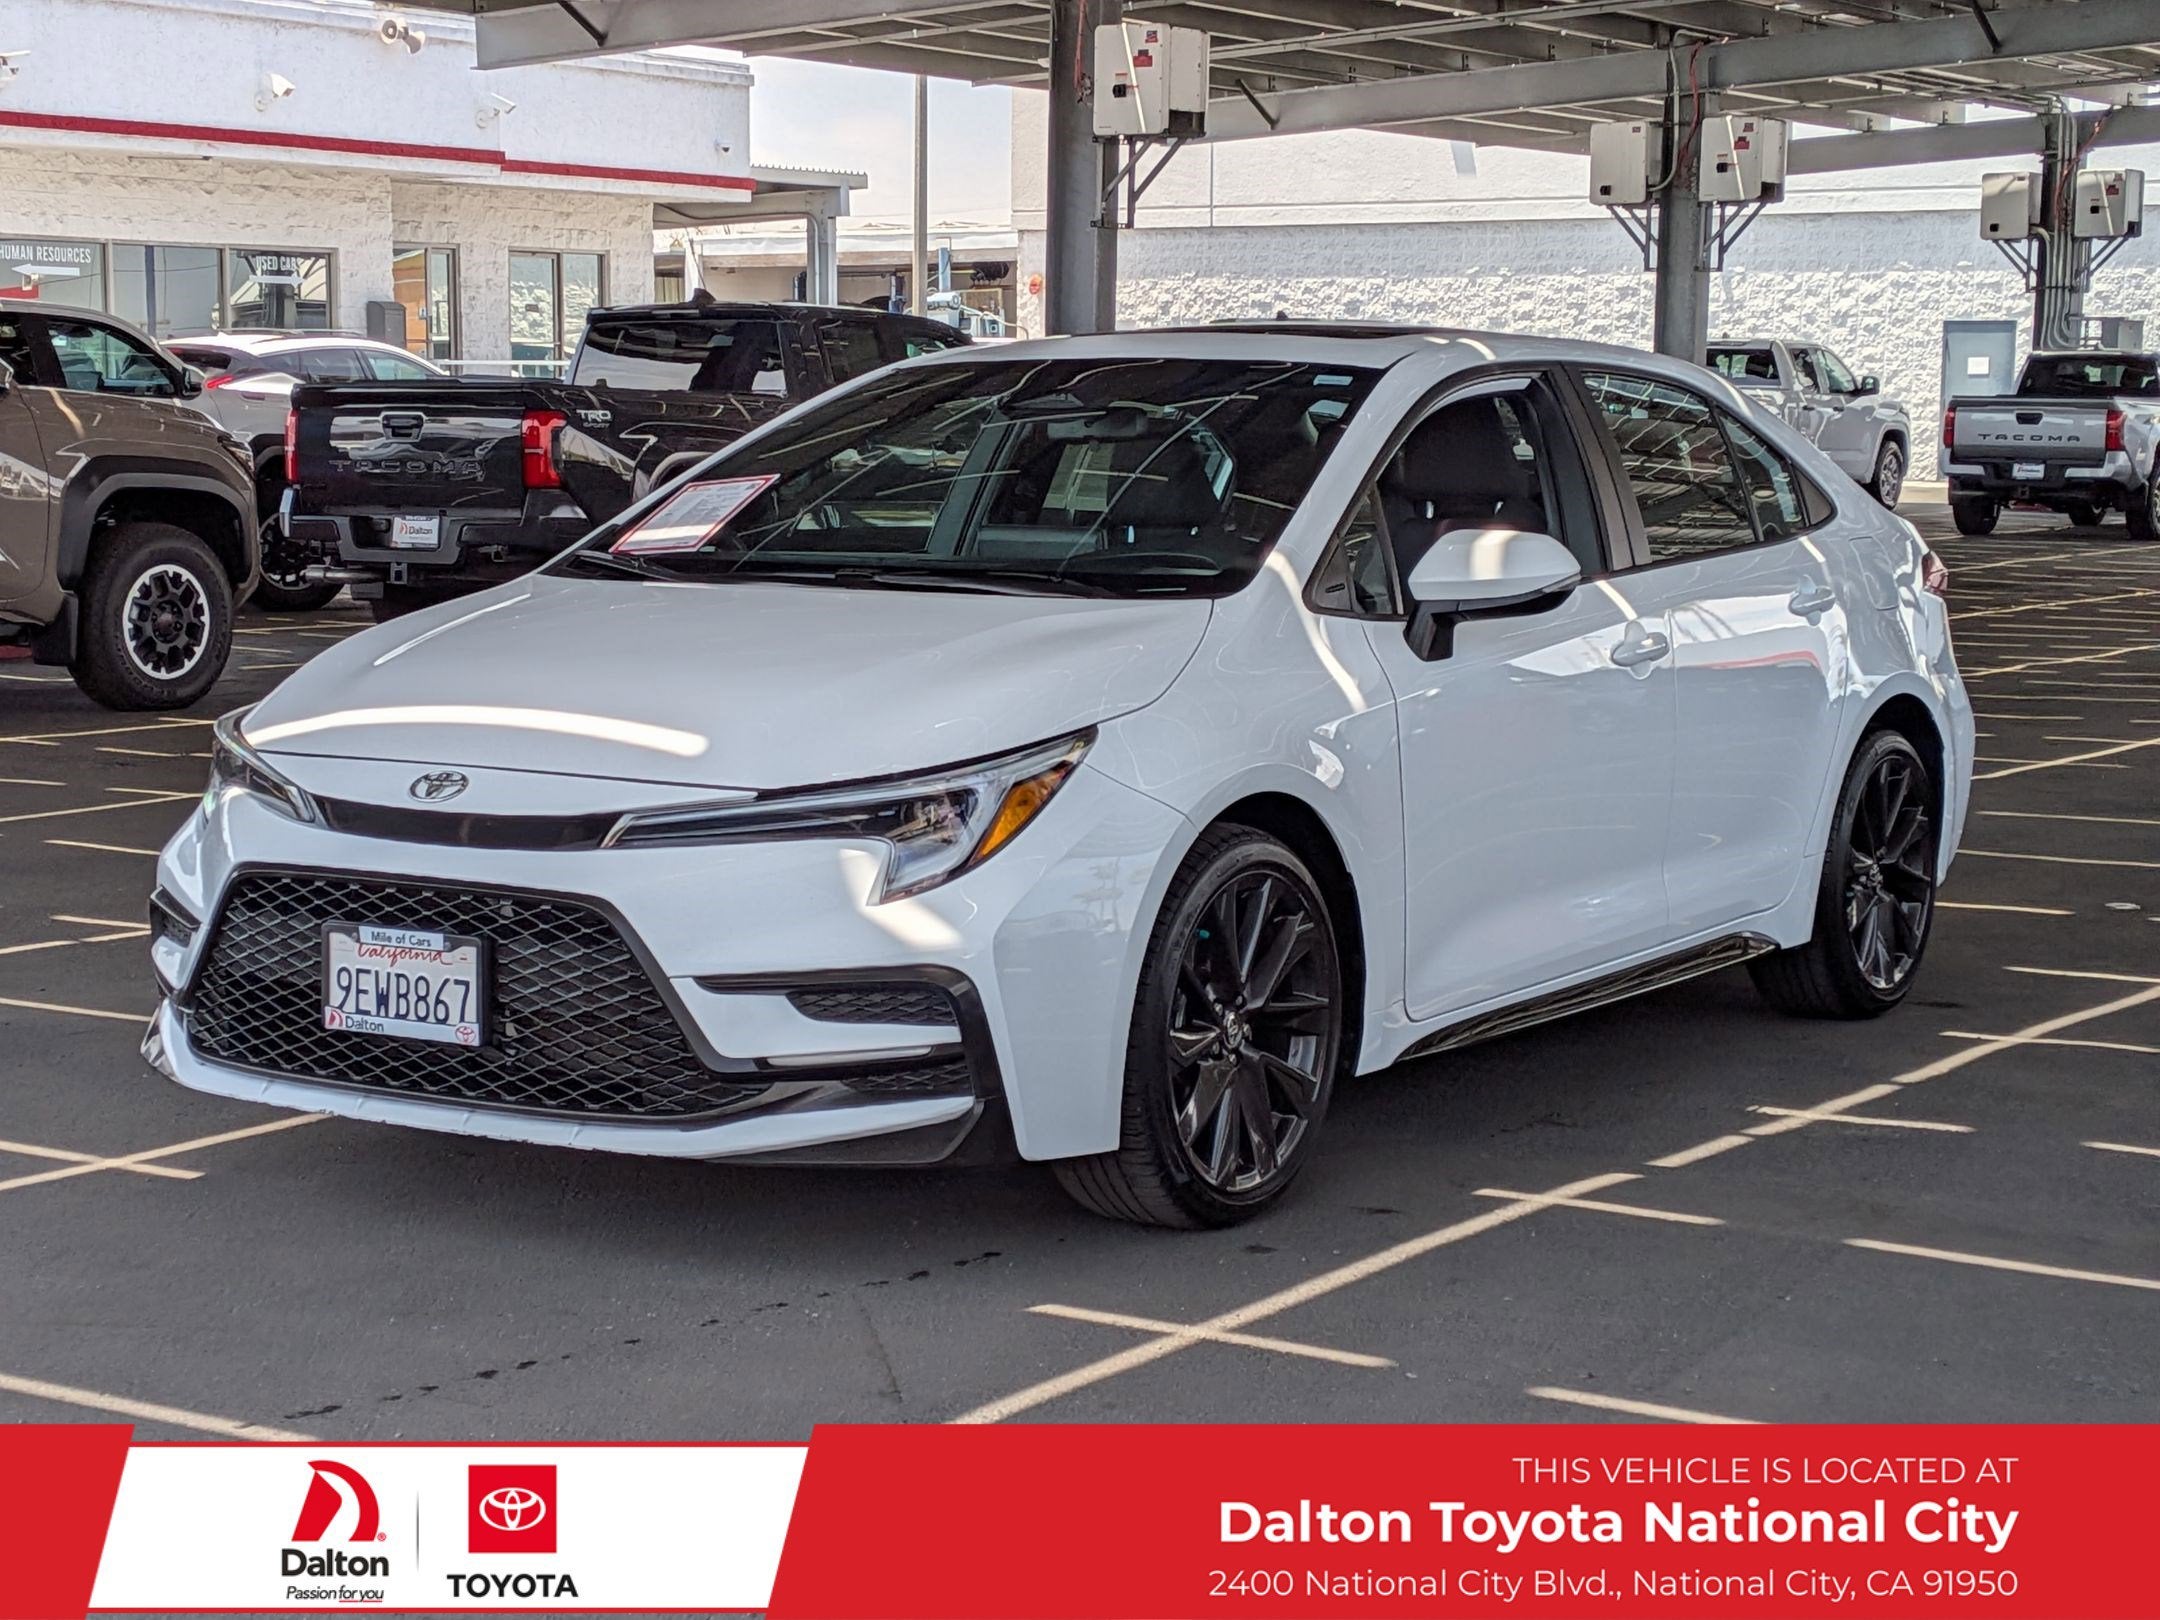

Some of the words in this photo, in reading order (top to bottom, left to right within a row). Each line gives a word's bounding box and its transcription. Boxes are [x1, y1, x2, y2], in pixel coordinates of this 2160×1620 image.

[0, 244, 34, 261] HUMAN
[36, 246, 92, 264] RESOURCES
[256, 255, 278, 270] USED
[576, 409, 612, 422] TRD
[1978, 433, 2081, 443] TACOMA
[328, 460, 482, 475] TACOMA
[371, 931, 392, 944] Mile
[395, 933, 407, 945] of
[408, 935, 432, 948] Cars
[336, 966, 471, 1026] 9EWB867
[345, 1015, 385, 1033] Dalton
